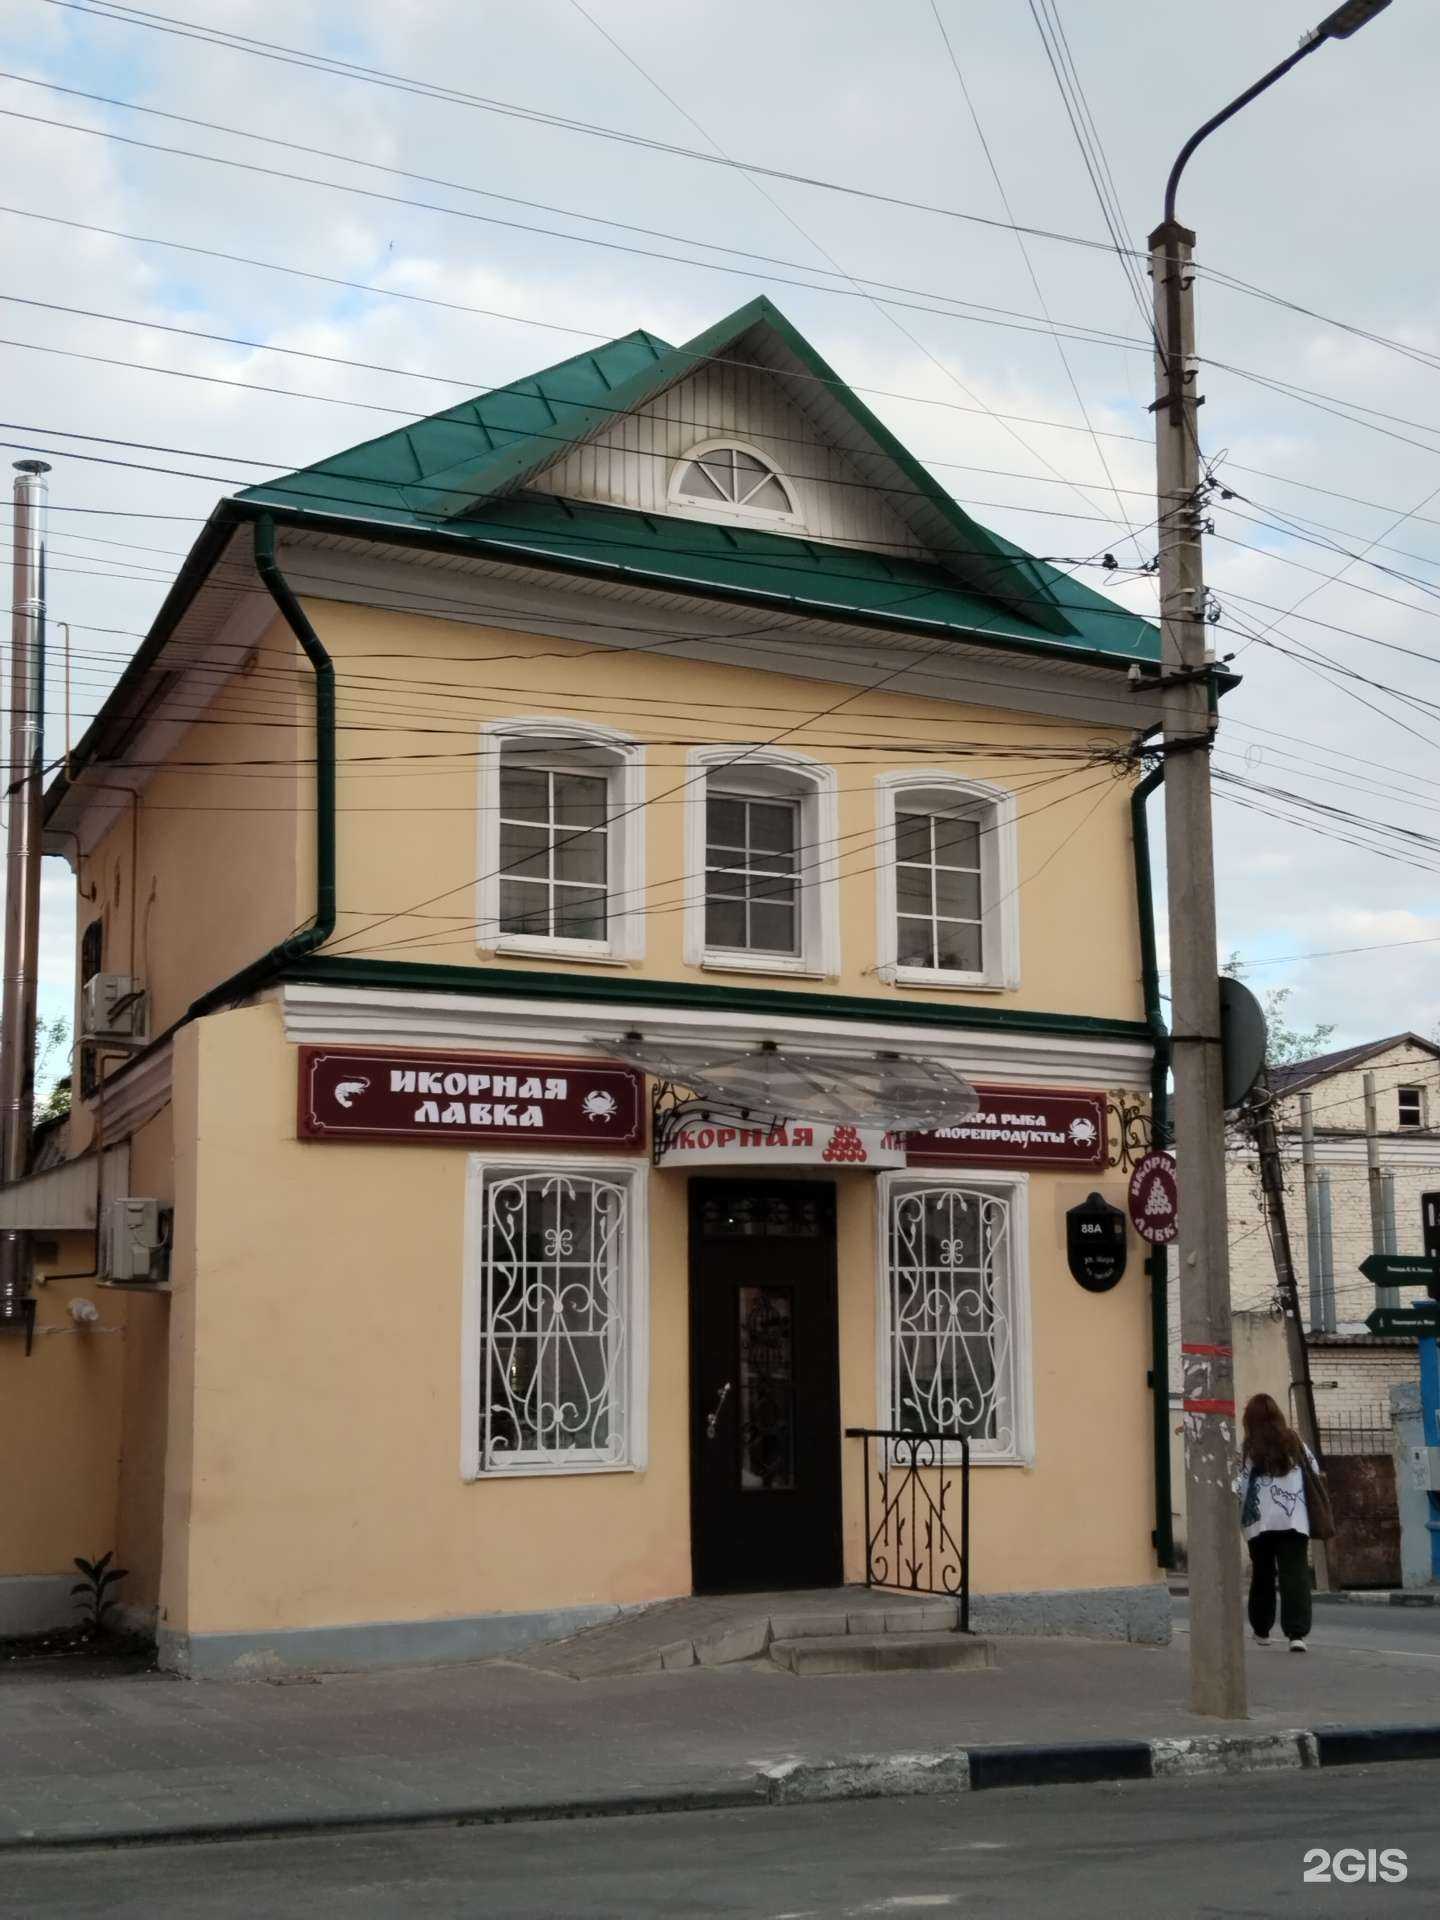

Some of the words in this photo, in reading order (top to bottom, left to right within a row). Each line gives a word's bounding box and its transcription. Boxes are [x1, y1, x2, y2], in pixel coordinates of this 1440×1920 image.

[390, 1070, 567, 1100] ИКОРНАЯ
[414, 1101, 544, 1127] ЛАВКА
[959, 1112, 997, 1125] КРА
[1001, 1113, 1046, 1126] РЫБА
[934, 1127, 1065, 1148] МОРЕПРОДУКТЫ
[1131, 1156, 1177, 1196] ИКОРНА
